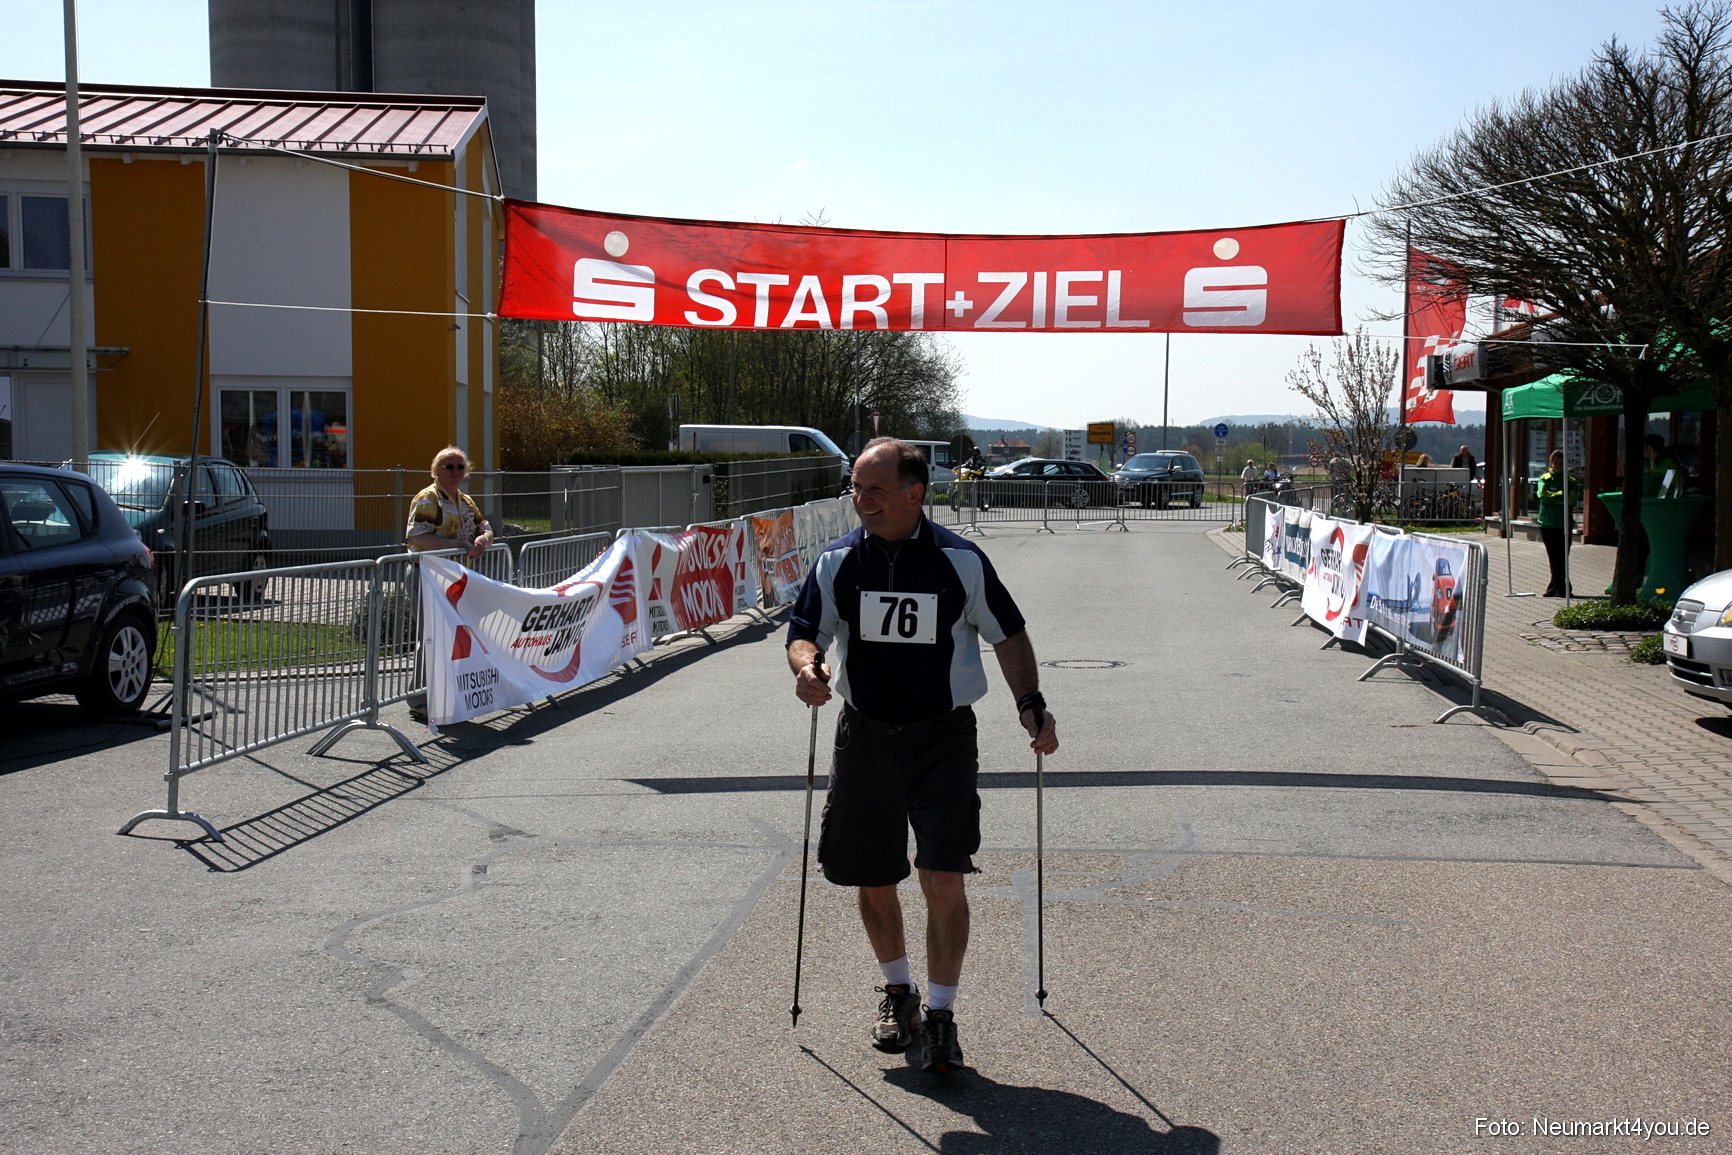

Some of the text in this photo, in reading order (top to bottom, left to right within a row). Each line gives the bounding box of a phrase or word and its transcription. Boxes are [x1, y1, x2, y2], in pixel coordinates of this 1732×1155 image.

[1454, 352, 1475, 371] SEAT
[521, 595, 594, 632] GERHART
[879, 595, 919, 639] 76
[510, 634, 553, 648] AUTOHAUS
[456, 667, 499, 691] MITSUBISHI
